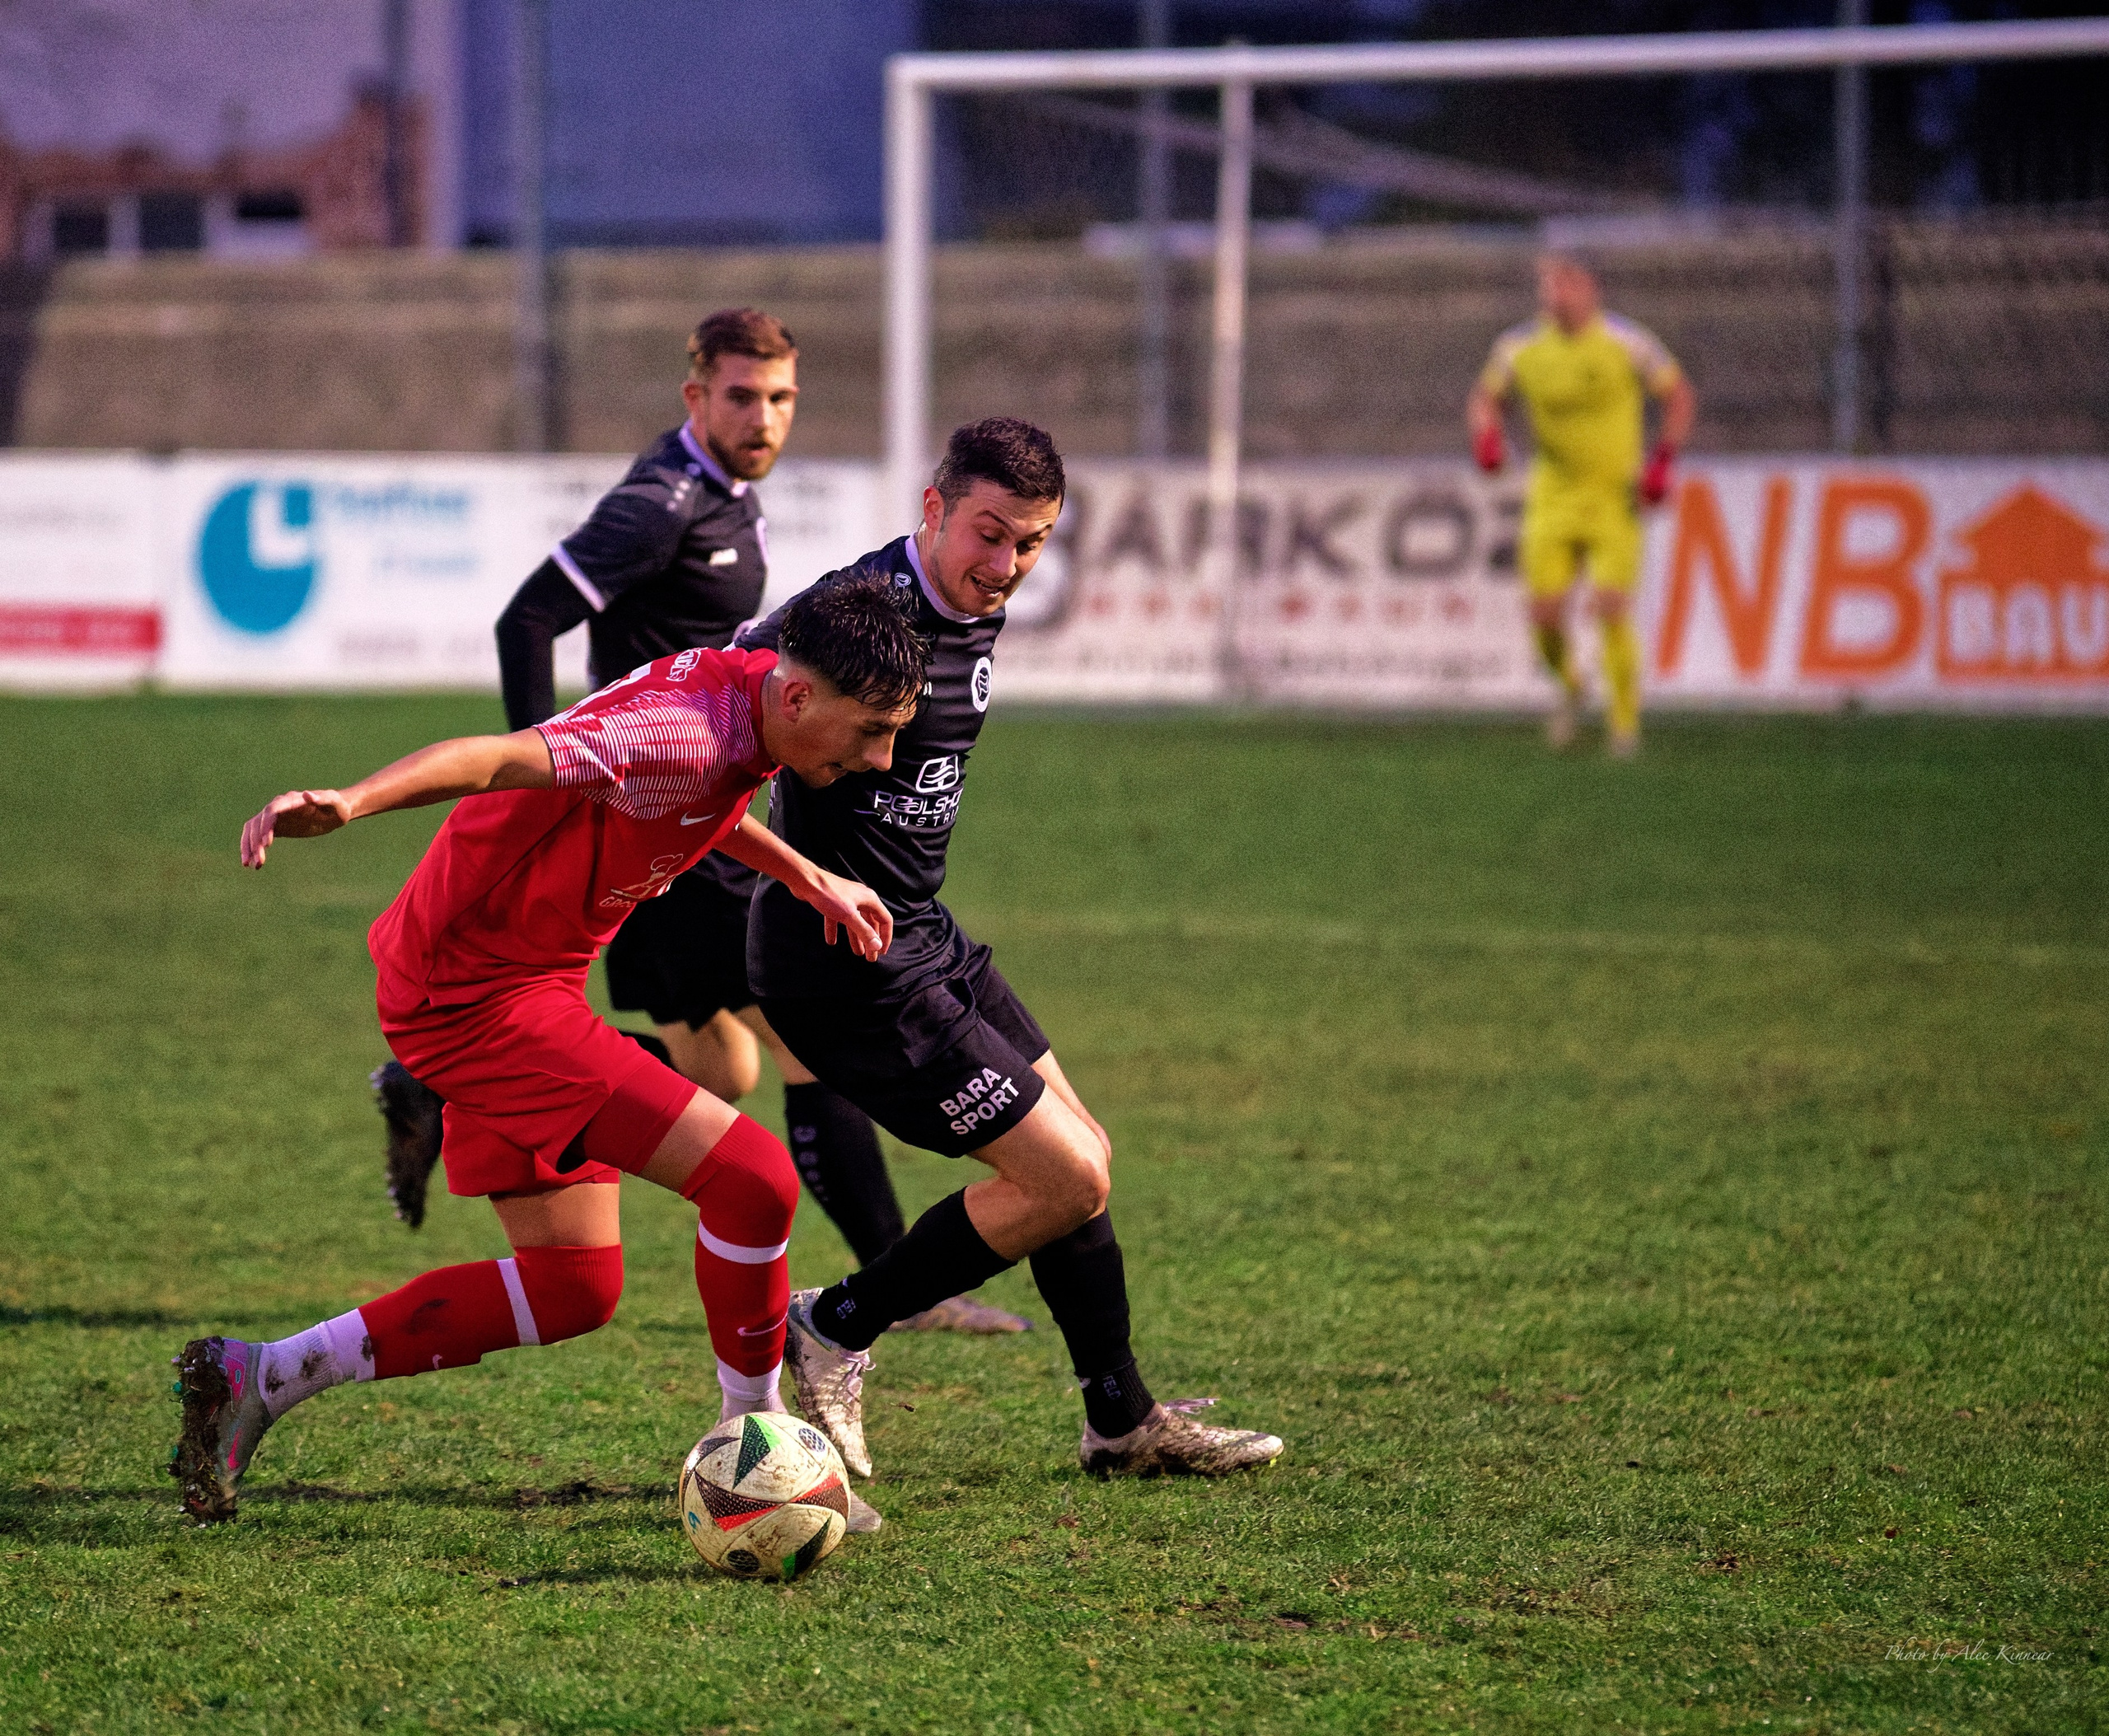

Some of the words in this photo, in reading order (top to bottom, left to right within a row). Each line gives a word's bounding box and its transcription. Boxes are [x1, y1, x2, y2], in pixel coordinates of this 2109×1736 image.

[1654, 478, 1932, 677] NB
[940, 1068, 1002, 1116] BARA
[951, 1077, 1019, 1135] SPORT
